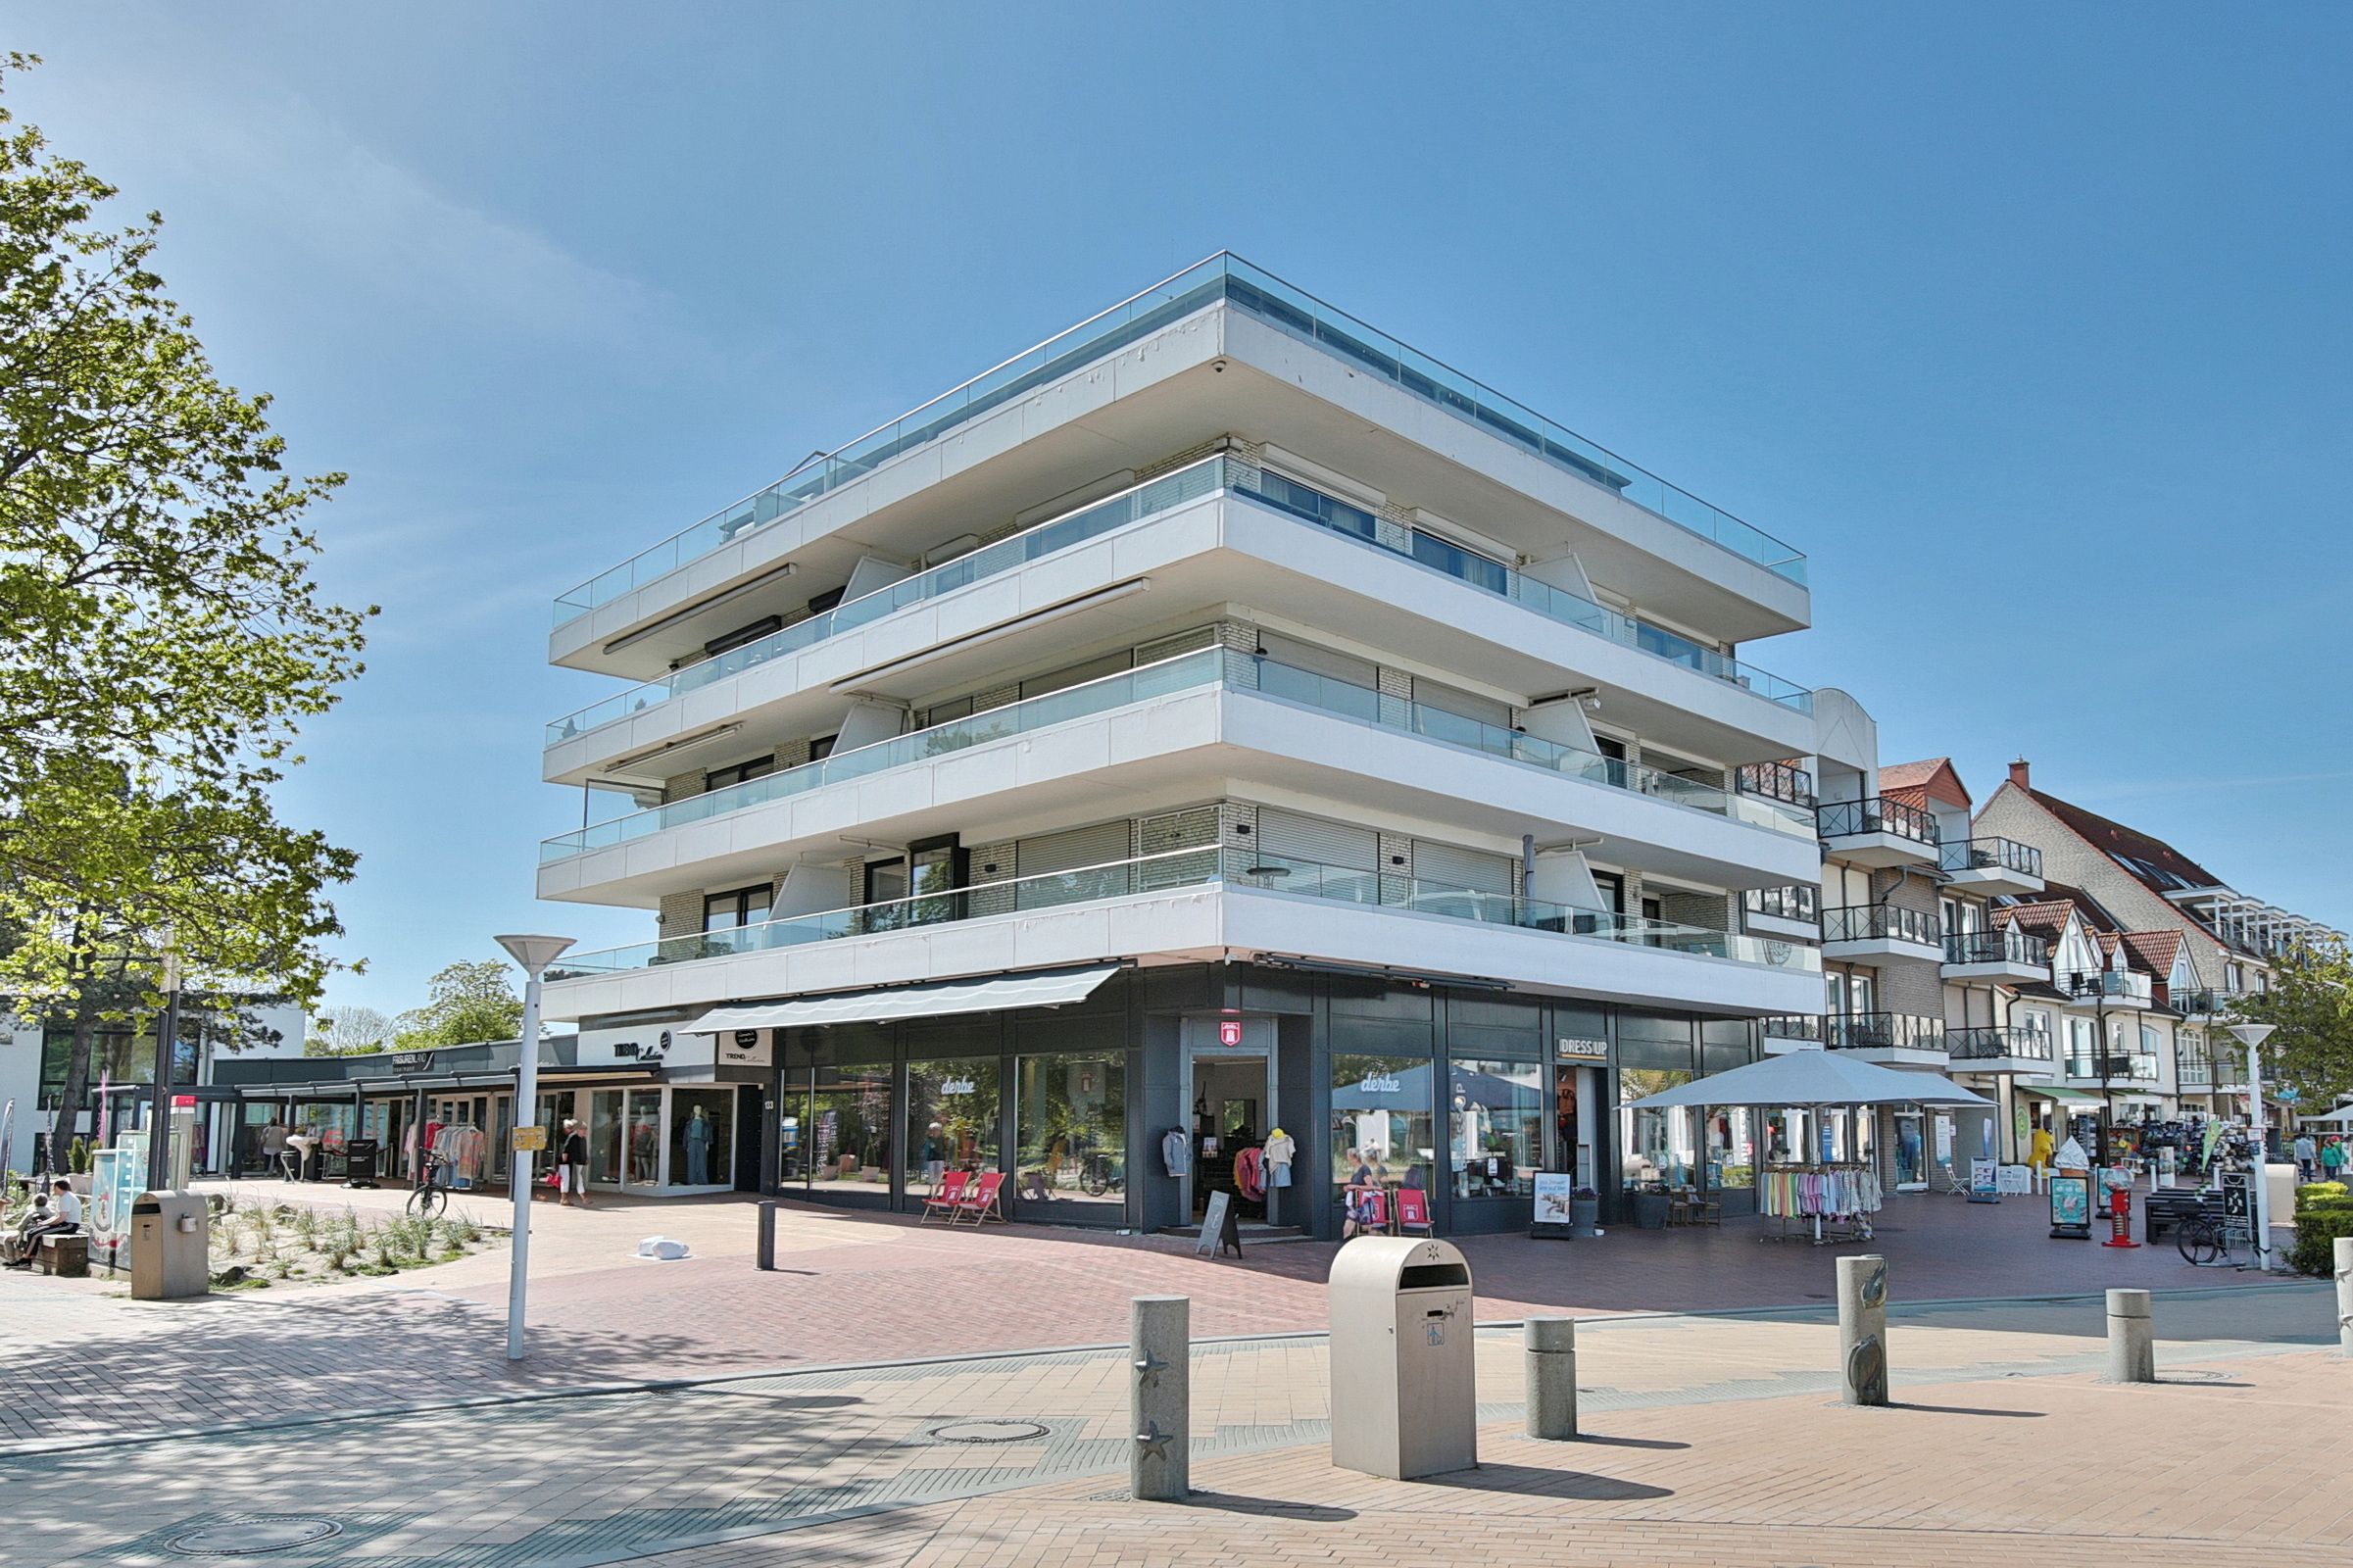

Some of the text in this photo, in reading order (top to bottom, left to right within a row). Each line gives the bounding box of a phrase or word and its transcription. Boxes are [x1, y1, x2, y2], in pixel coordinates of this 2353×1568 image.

[1559, 1039, 1607, 1054] DRESS UP
[941, 1075, 976, 1095] derbe
[1361, 1071, 1400, 1092] derbe
